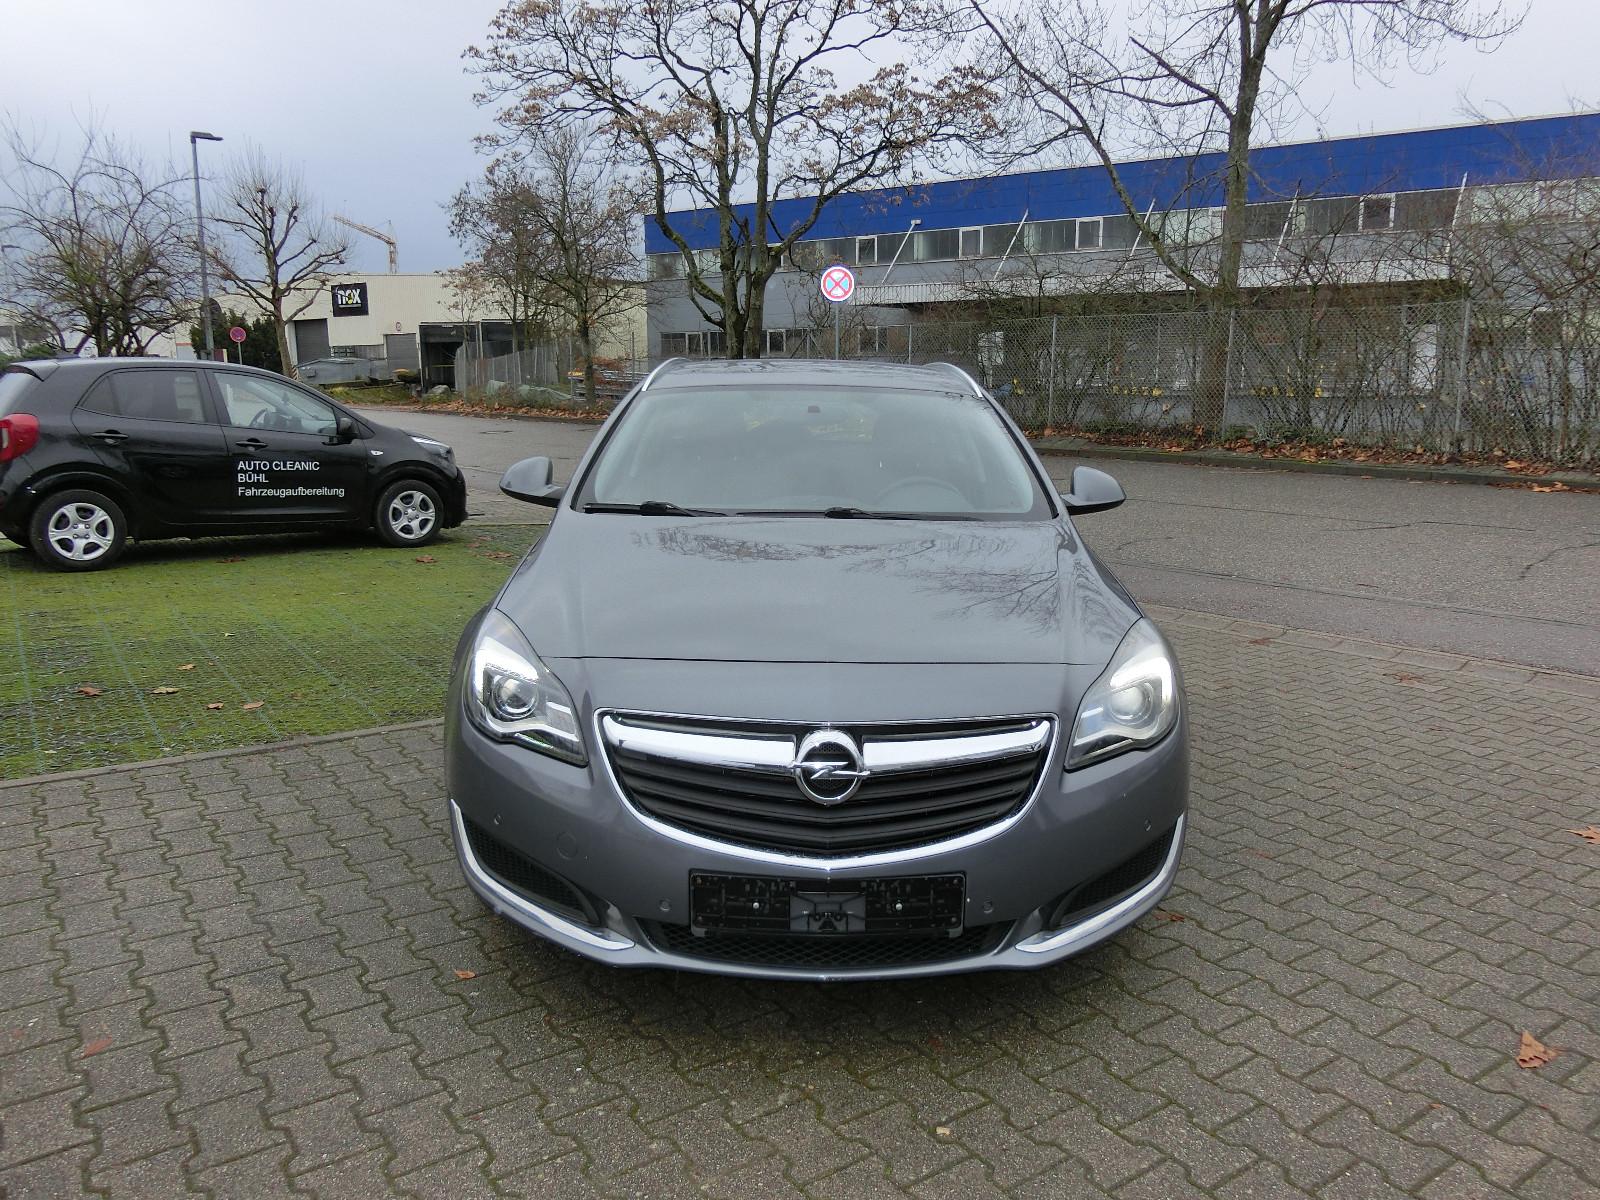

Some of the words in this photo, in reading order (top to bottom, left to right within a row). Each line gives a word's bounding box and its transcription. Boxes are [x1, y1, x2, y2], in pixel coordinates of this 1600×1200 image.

[237, 461, 270, 471] AUTO
[272, 461, 320, 471] CLEANIC
[237, 472, 269, 483] BÜHL
[238, 487, 345, 498] Fahrzeugaufbereitung
